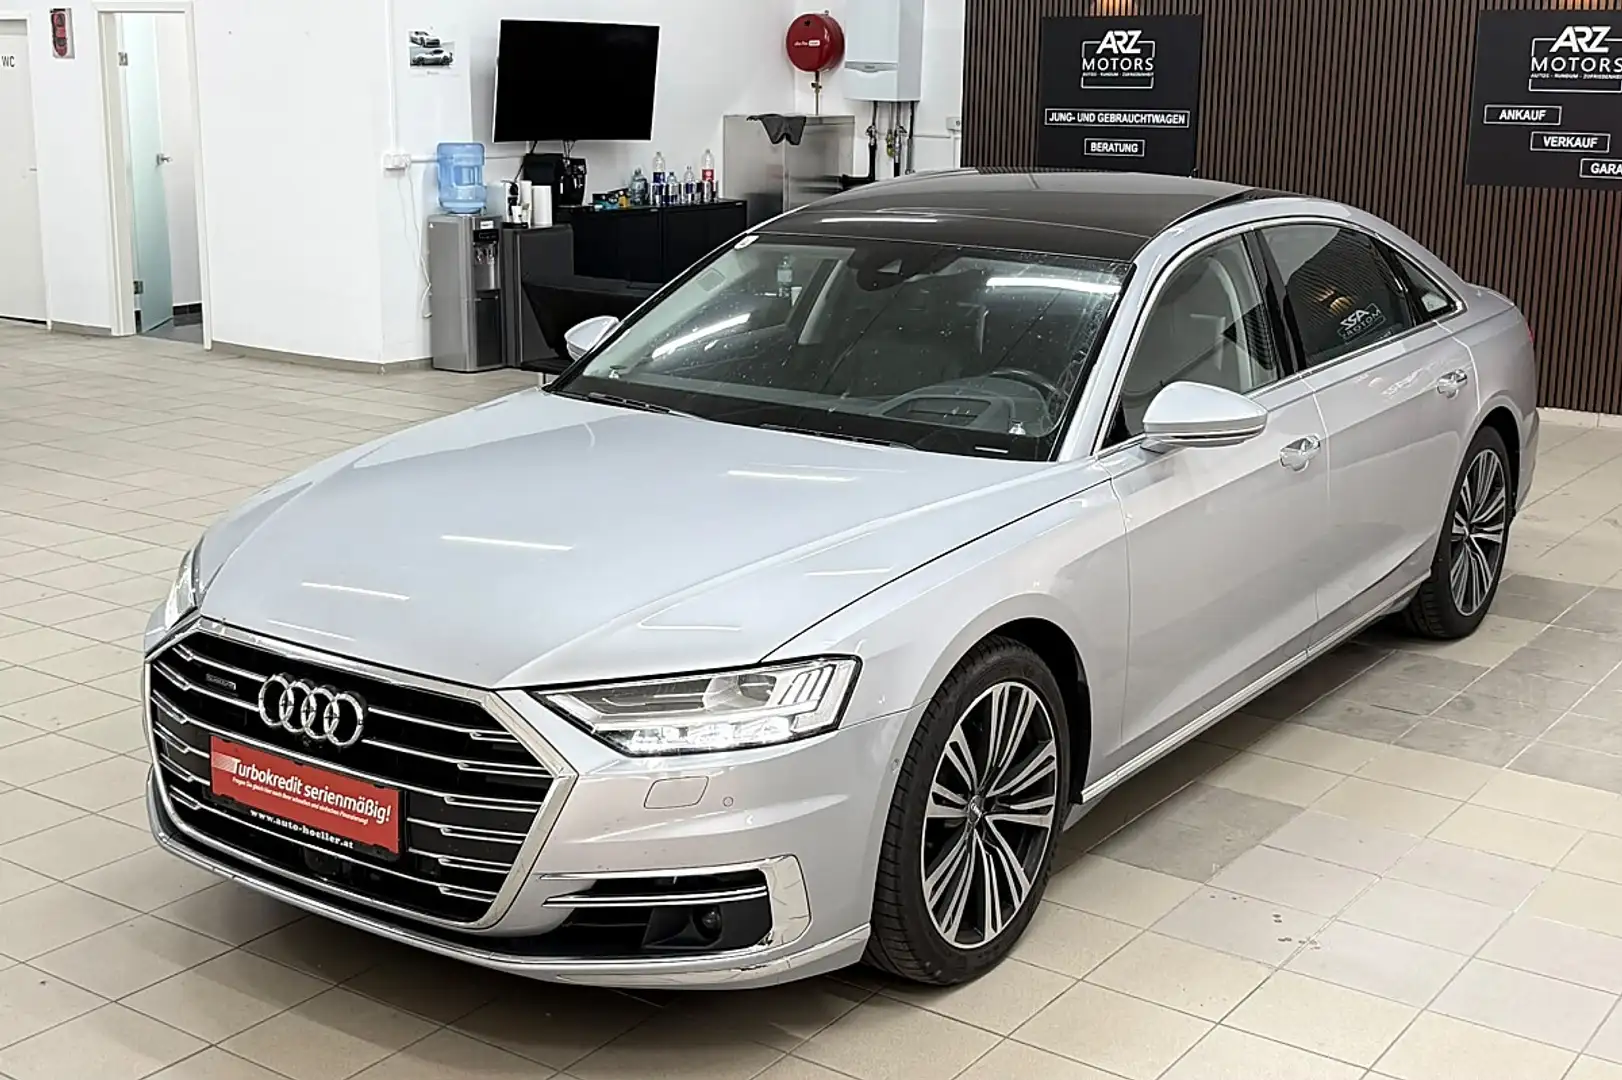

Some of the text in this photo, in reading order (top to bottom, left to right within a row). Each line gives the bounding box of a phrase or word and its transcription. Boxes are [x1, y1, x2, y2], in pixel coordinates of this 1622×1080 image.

[1095, 29, 1142, 54] ARZ
[1549, 25, 1612, 53] ARZ
[1, 55, 15, 68] WC
[1081, 57, 1154, 71] MOTORS
[1531, 56, 1622, 72] MOTORS
[1049, 112, 1186, 125] JUNG- UND GEBRAUCHTWAGEN
[1499, 109, 1547, 121] ANKAUF
[1090, 142, 1139, 153] BERATUNG
[1543, 135, 1599, 149] VERKAUF
[1590, 162, 1622, 175] GARA
[231, 757, 303, 796] Turbokredit
[303, 784, 392, 825] serienmäßig!
